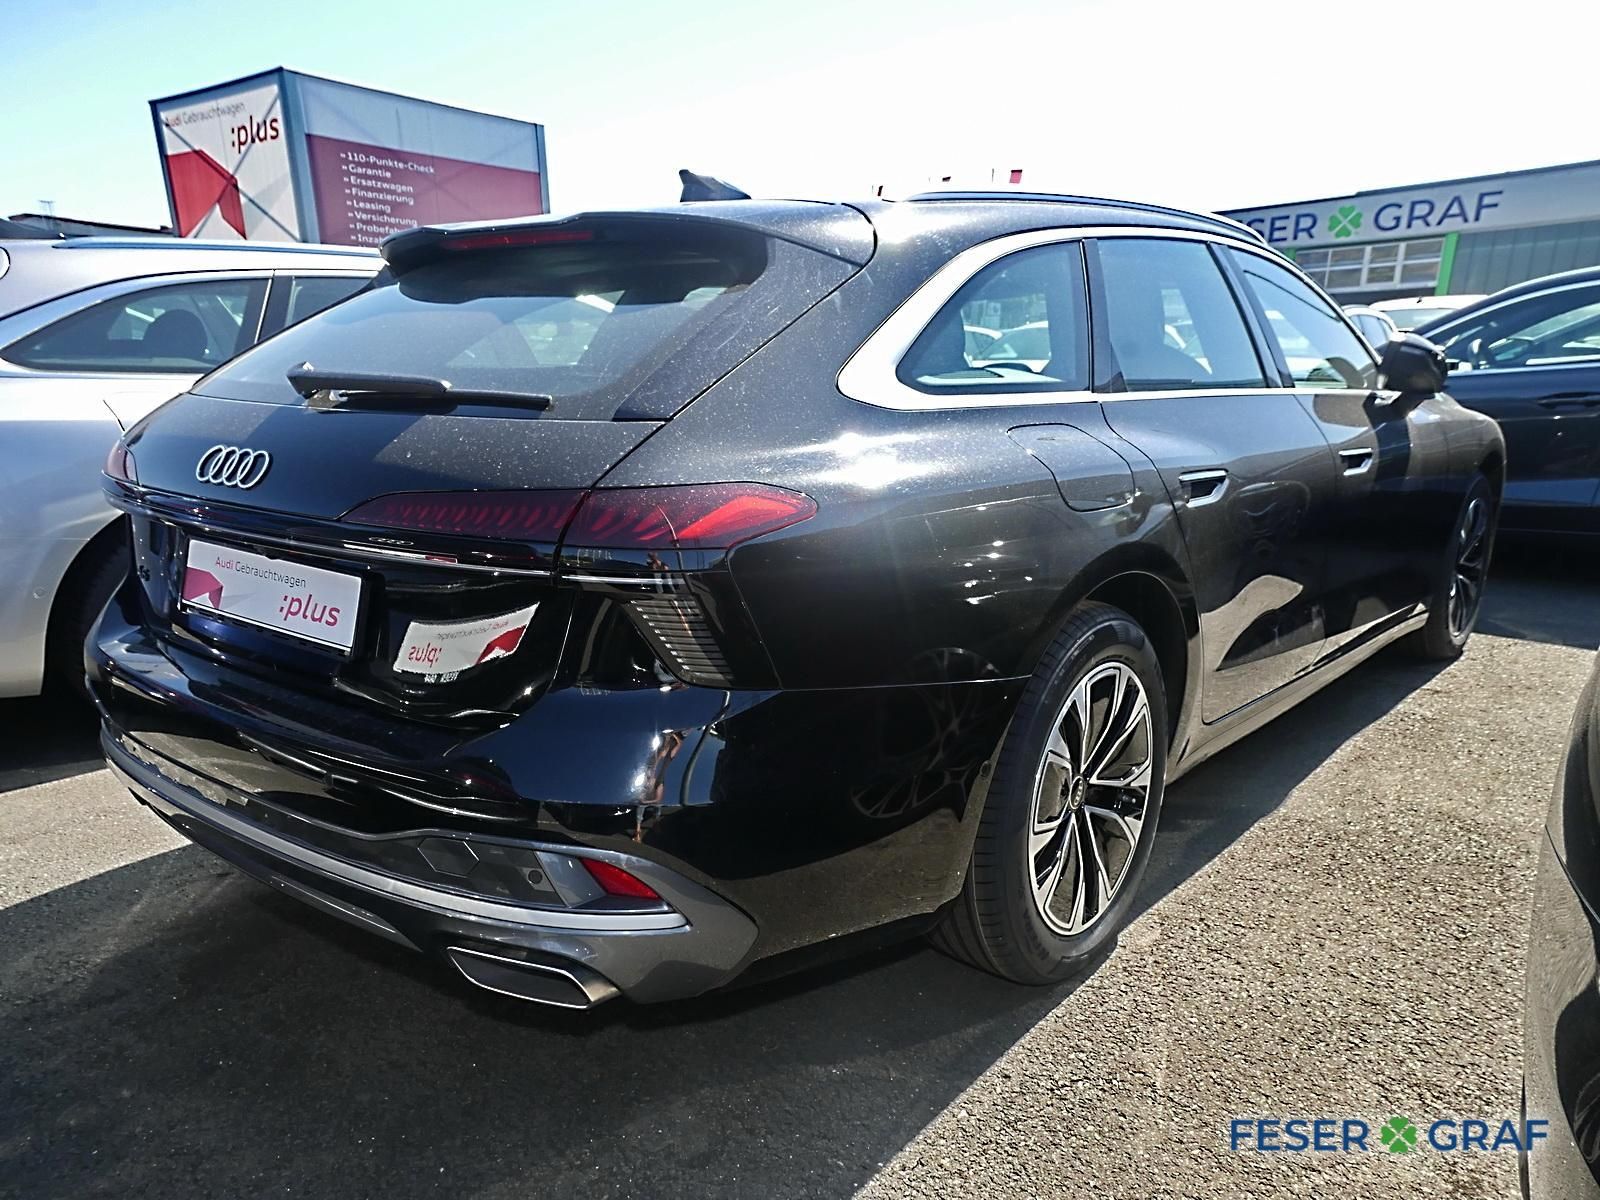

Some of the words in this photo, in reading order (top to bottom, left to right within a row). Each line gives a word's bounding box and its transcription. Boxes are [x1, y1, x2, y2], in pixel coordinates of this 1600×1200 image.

[231, 115, 280, 154] :plus
[348, 164, 392, 178] Garantie
[350, 176, 414, 193] Ersatzwagen
[352, 188, 415, 206] Finanzierung
[353, 199, 391, 213] Leasing
[1374, 190, 1503, 231] GRAF
[354, 211, 418, 229] Versicherung
[215, 556, 234, 570] Audi
[235, 561, 307, 589] Gebrauchtwagen
[279, 593, 341, 627] :plus
